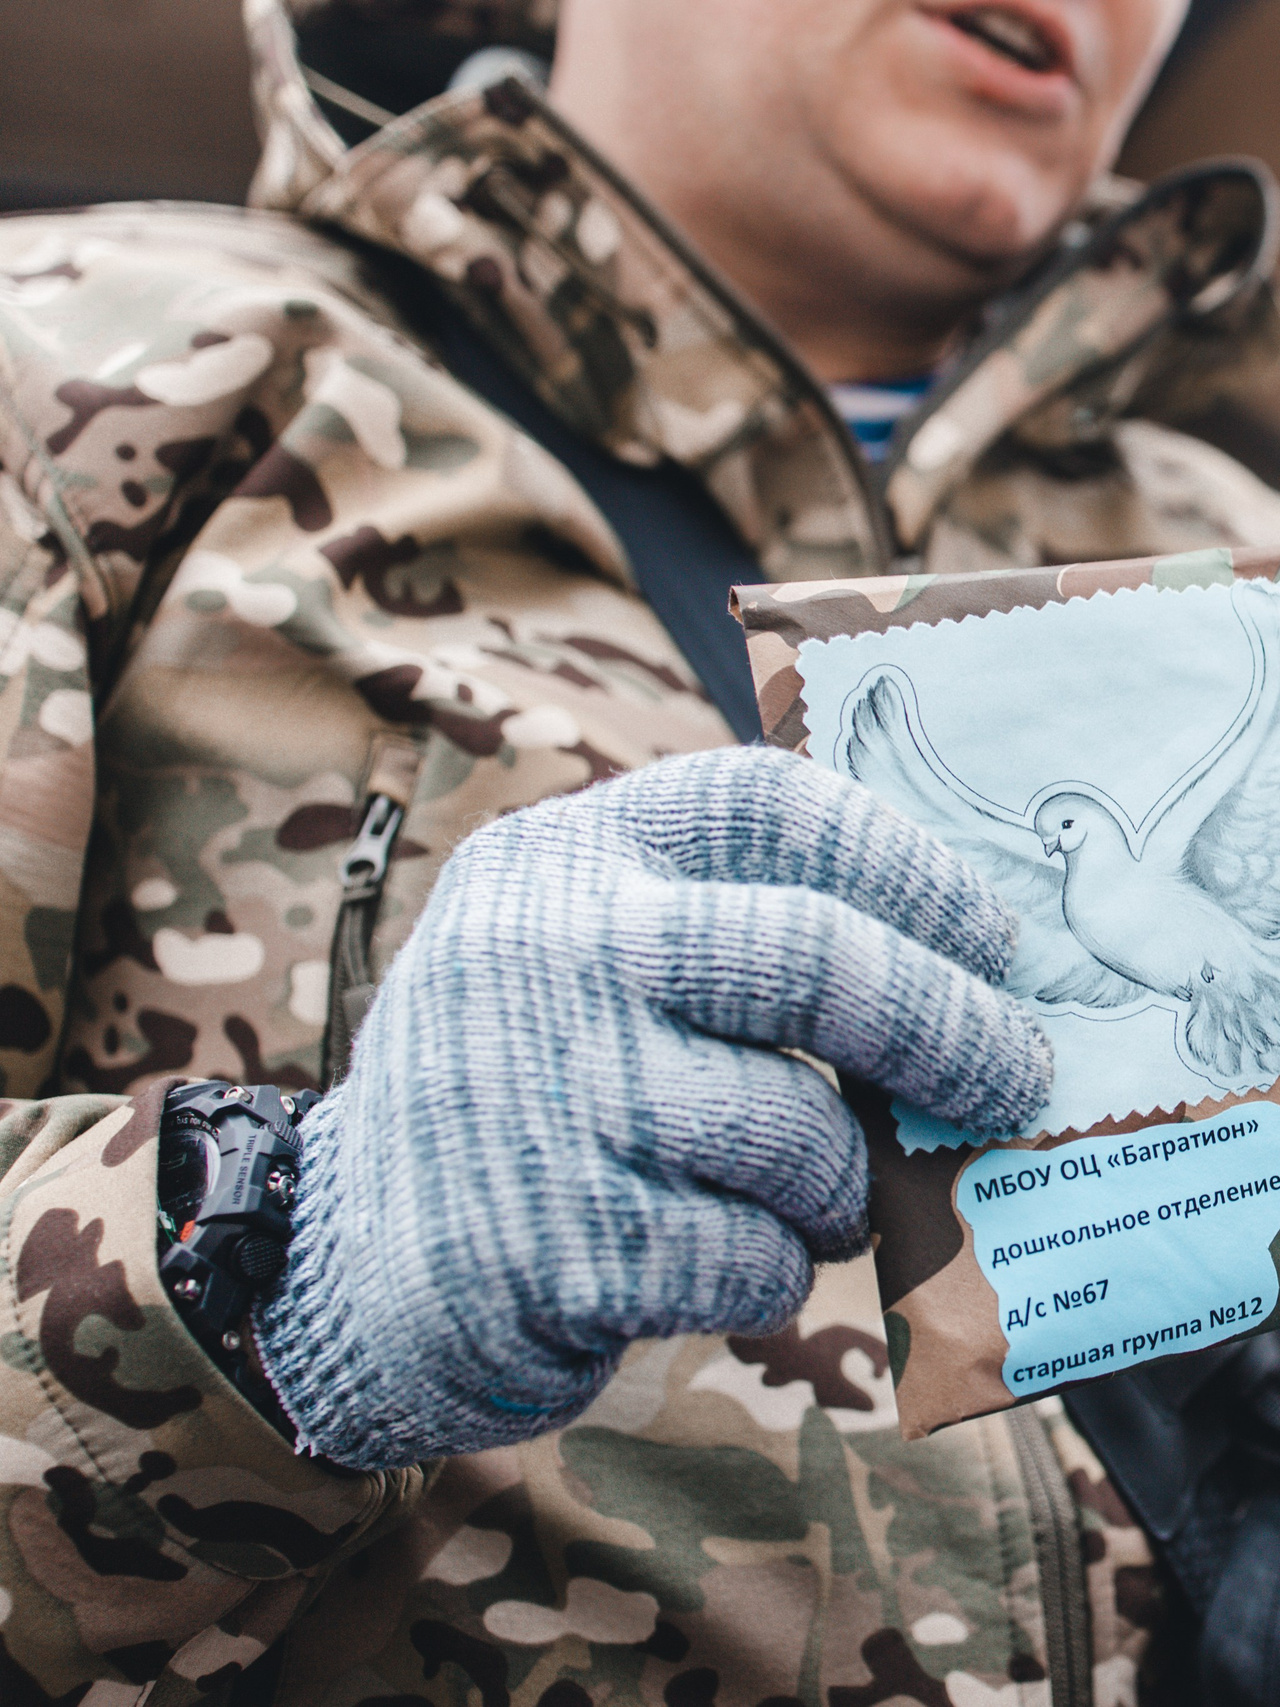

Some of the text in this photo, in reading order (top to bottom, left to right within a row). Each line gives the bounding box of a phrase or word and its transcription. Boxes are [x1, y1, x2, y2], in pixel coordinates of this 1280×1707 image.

[233, 1135, 256, 1205] TRIPLE SENSOR
[973, 1118, 1259, 1203] МБОУ ОЦ «Багратион»
[991, 1209, 1151, 1269] дошкольное
[1006, 1278, 1110, 1332] д/с №67
[1012, 1296, 1264, 1383] старшая группа №12
